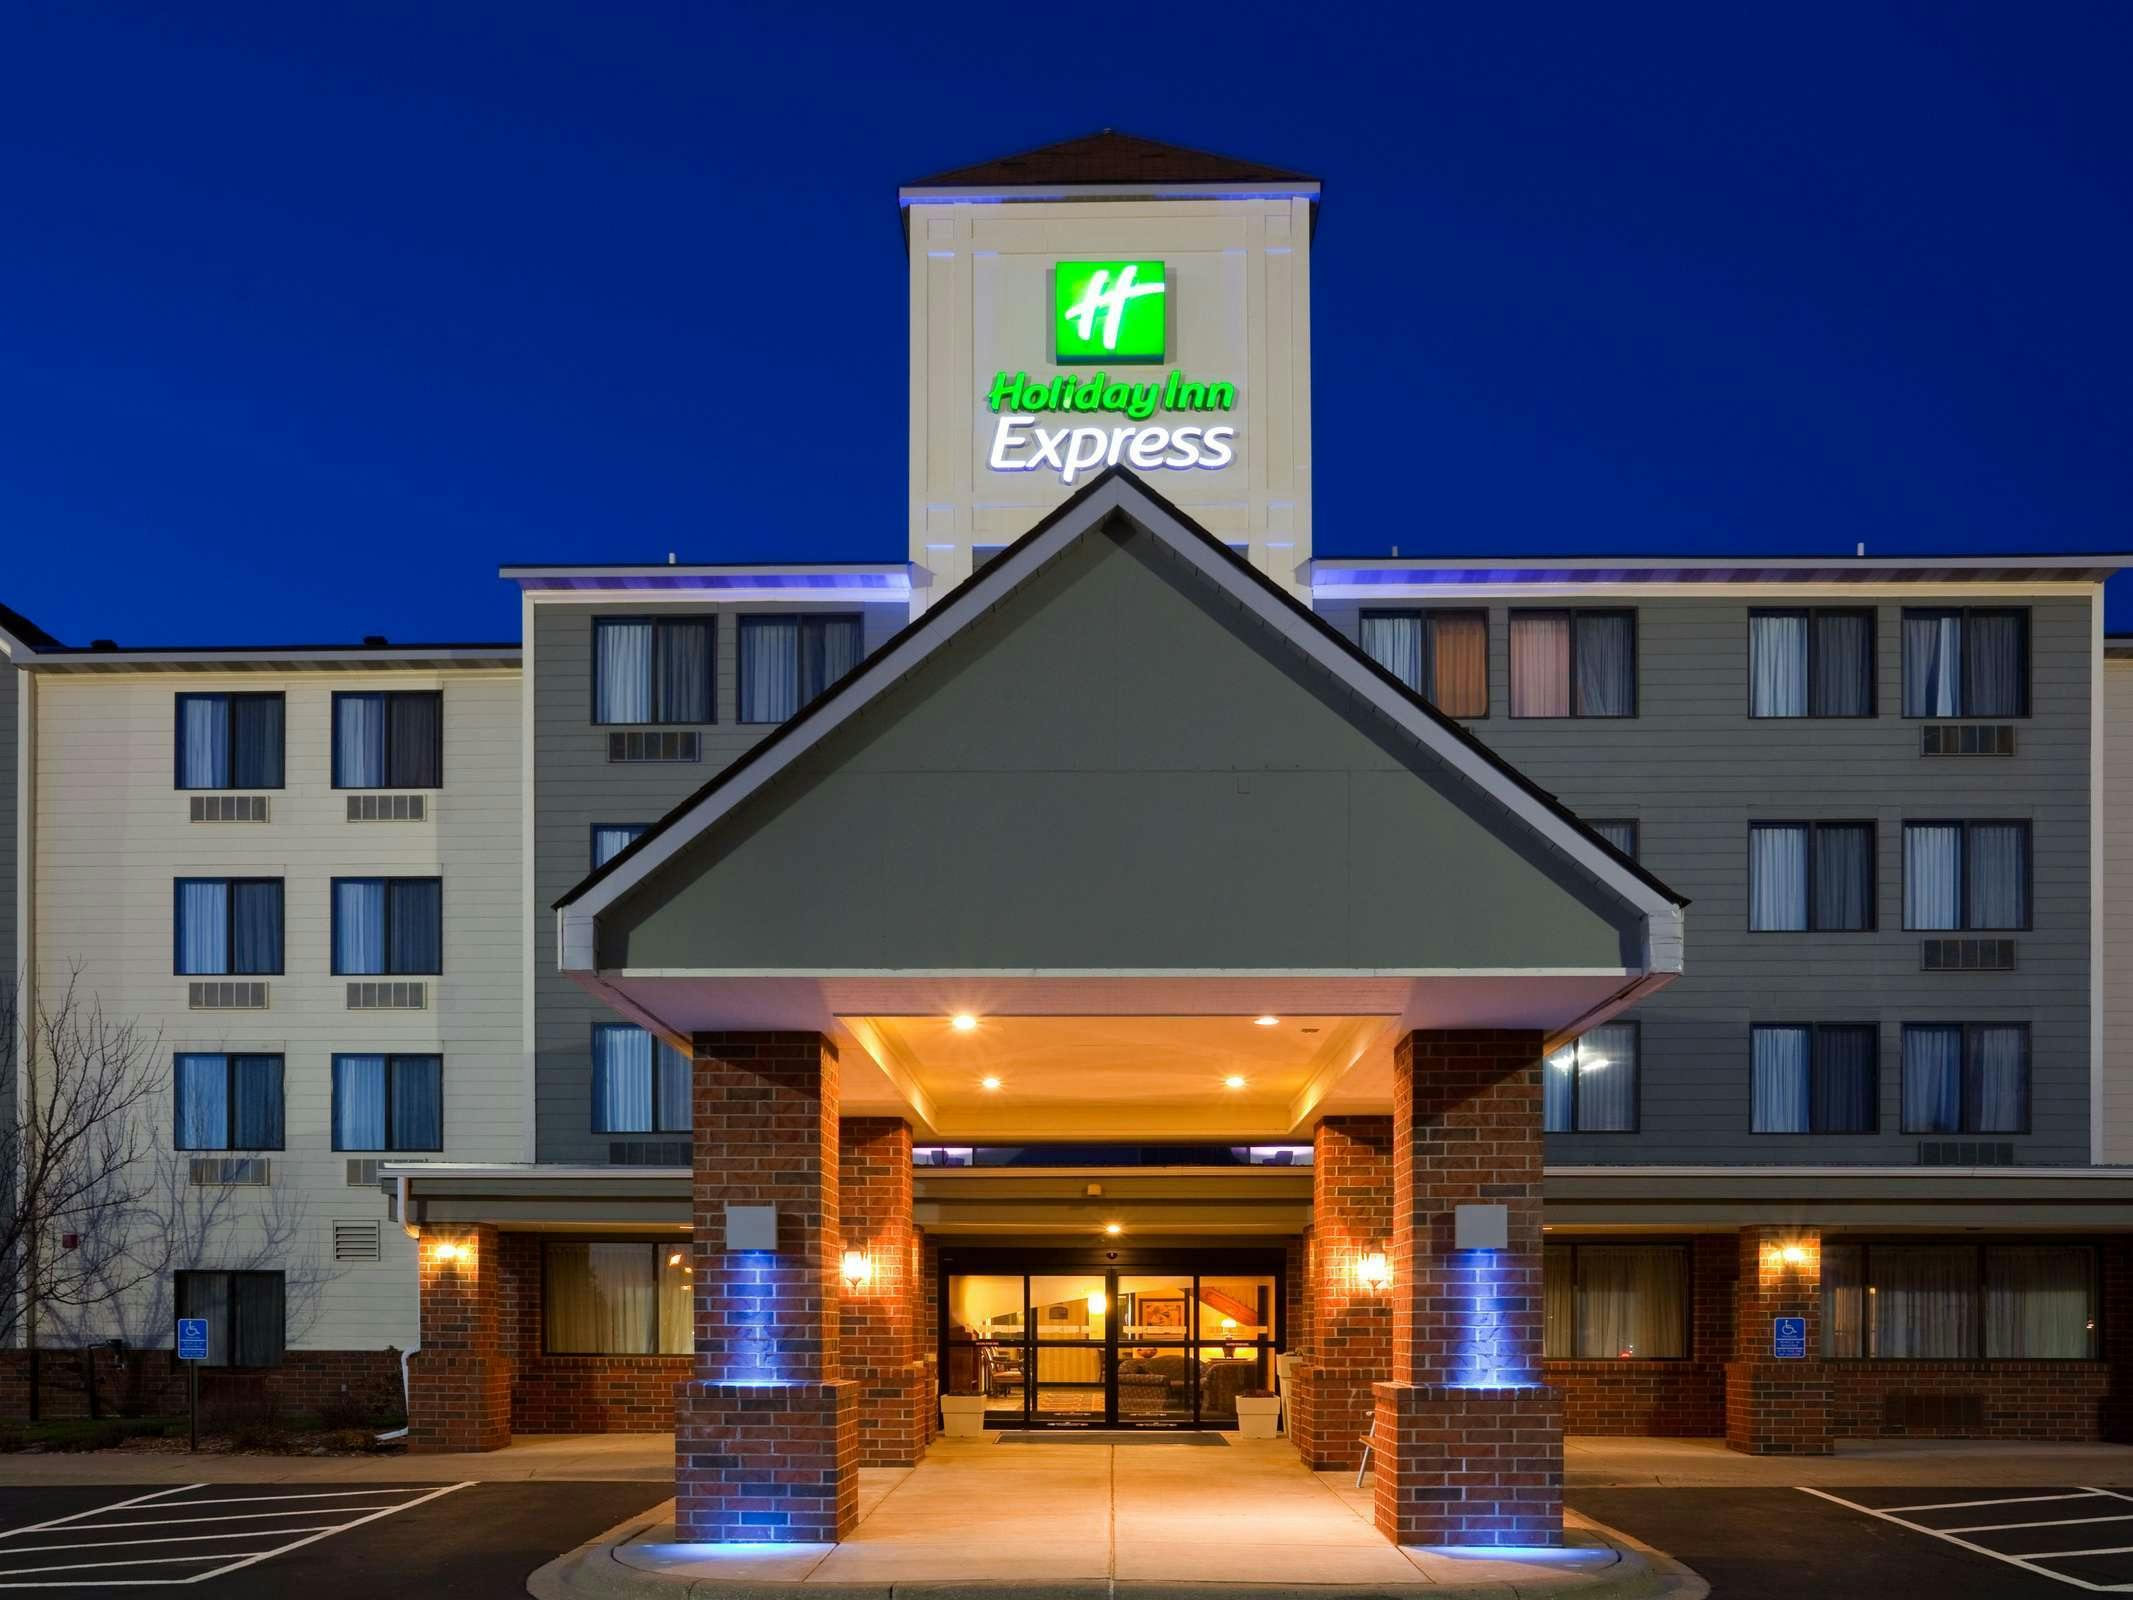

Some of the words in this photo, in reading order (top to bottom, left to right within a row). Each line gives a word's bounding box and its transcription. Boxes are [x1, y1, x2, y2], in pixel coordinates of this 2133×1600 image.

[988, 371, 1159, 421] Holiday
[1164, 371, 1235, 412] Inn
[989, 416, 1235, 484] Express
